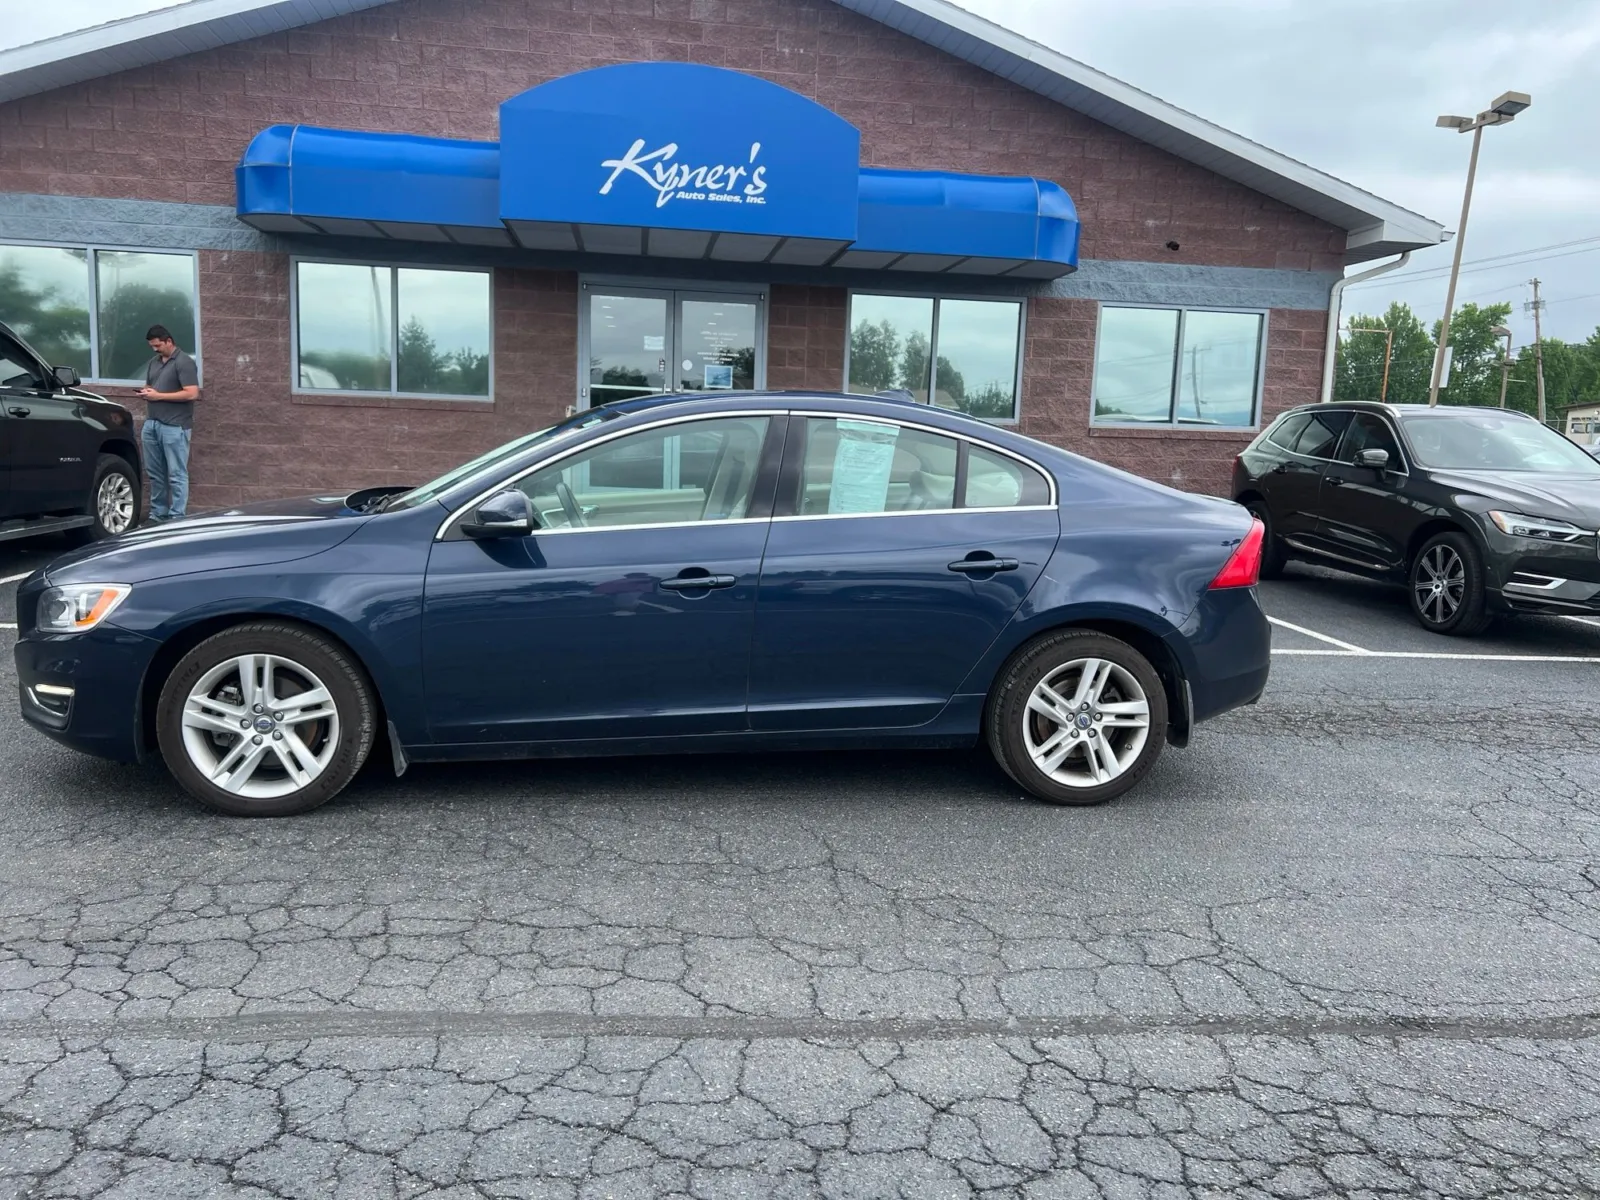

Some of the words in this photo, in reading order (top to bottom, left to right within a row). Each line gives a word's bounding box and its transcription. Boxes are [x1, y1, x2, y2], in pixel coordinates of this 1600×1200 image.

[599, 139, 767, 208] Kyner's
[676, 191, 705, 200] Auto
[708, 193, 743, 203] Sales,
[746, 196, 766, 204] Inc.
